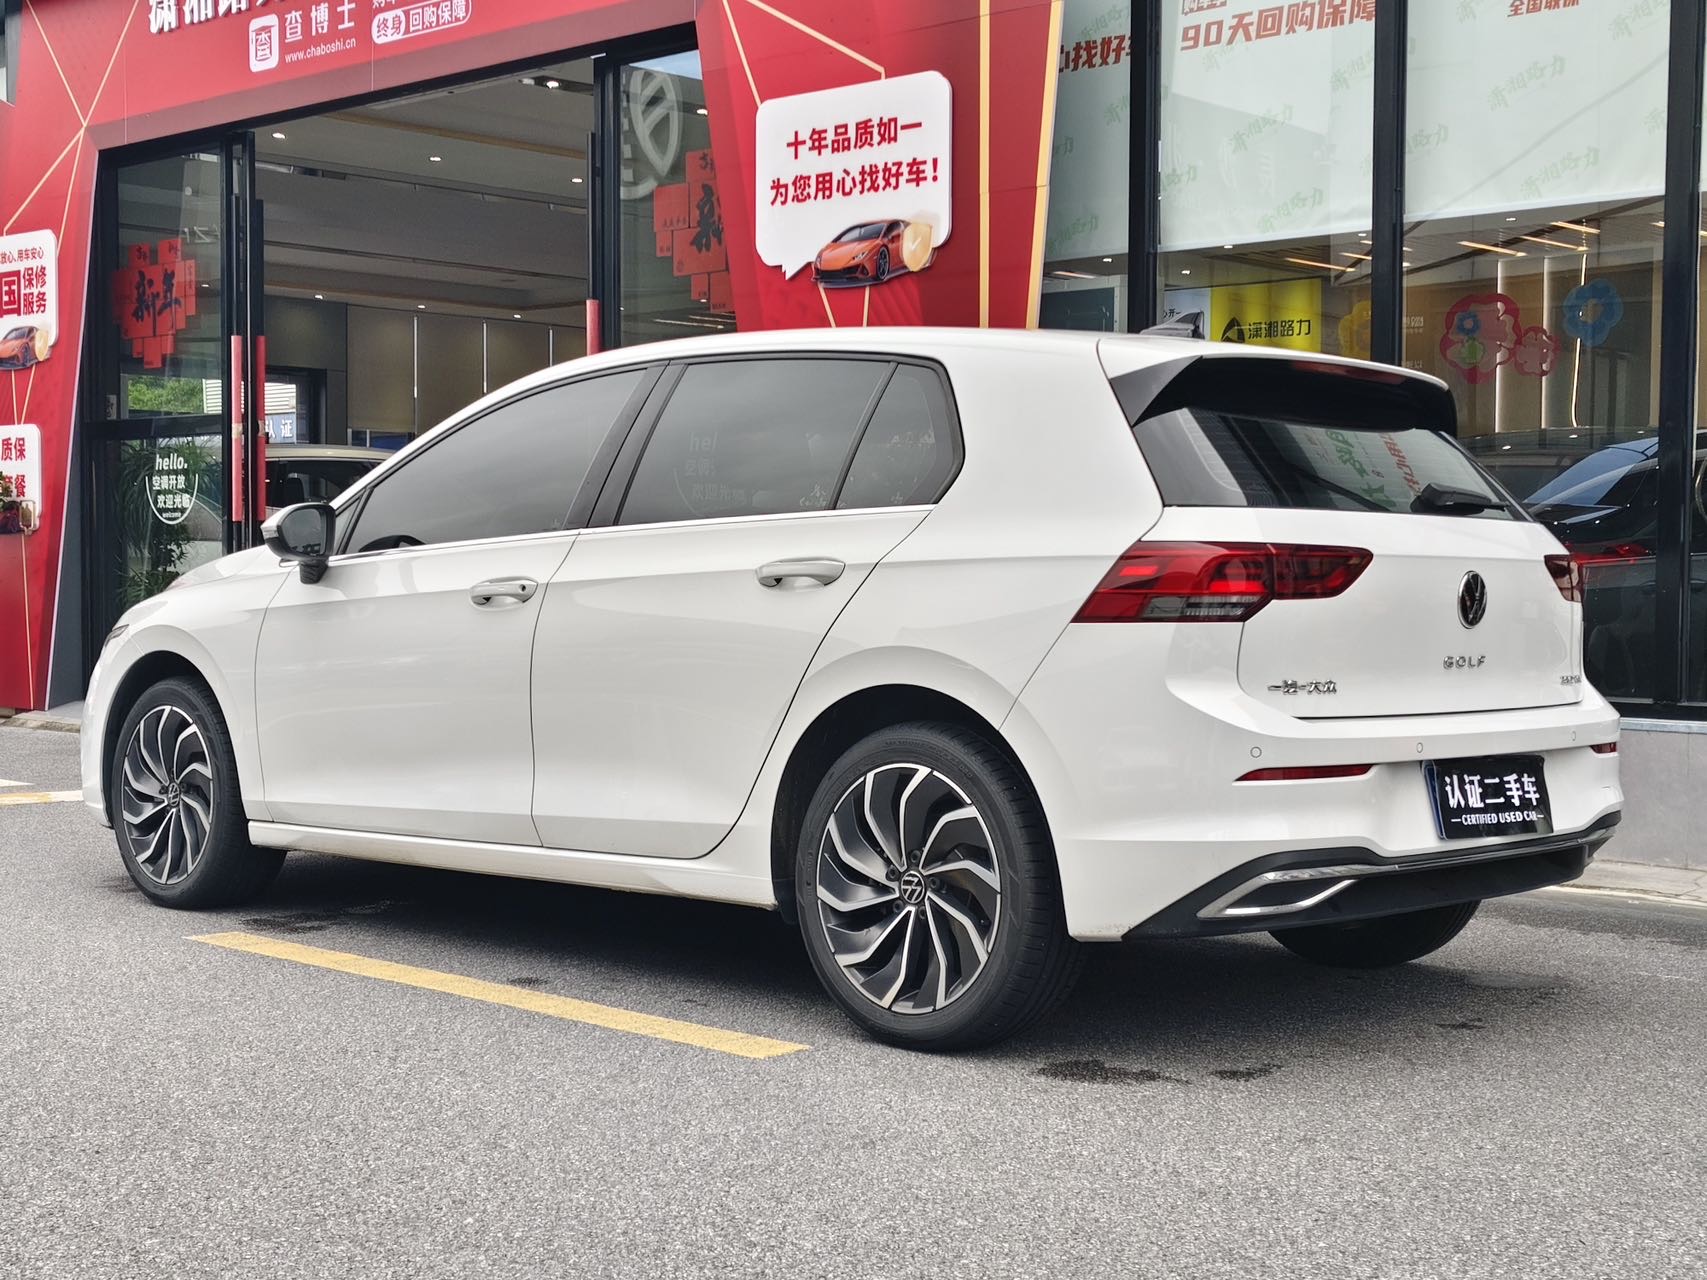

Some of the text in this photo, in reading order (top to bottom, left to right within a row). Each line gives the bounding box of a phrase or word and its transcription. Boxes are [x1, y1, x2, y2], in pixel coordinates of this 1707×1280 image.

[285, 0, 357, 43] 查博士
[376, 1, 467, 39] 终身 回购保障
[285, 38, 357, 63] www.chaboshi.cn
[786, 116, 923, 160] 十年品质如一
[769, 157, 939, 206] 为您用心找好车！
[22, 265, 47, 291] 保修
[22, 291, 47, 316] 服务
[1247, 319, 1312, 340] 潇湘路力
[1, 437, 26, 461] 质保
[1443, 655, 1486, 669] GOLF
[1444, 773, 1540, 809] 认证二手车
[1461, 811, 1538, 825] CERTIFIED USED CAR
